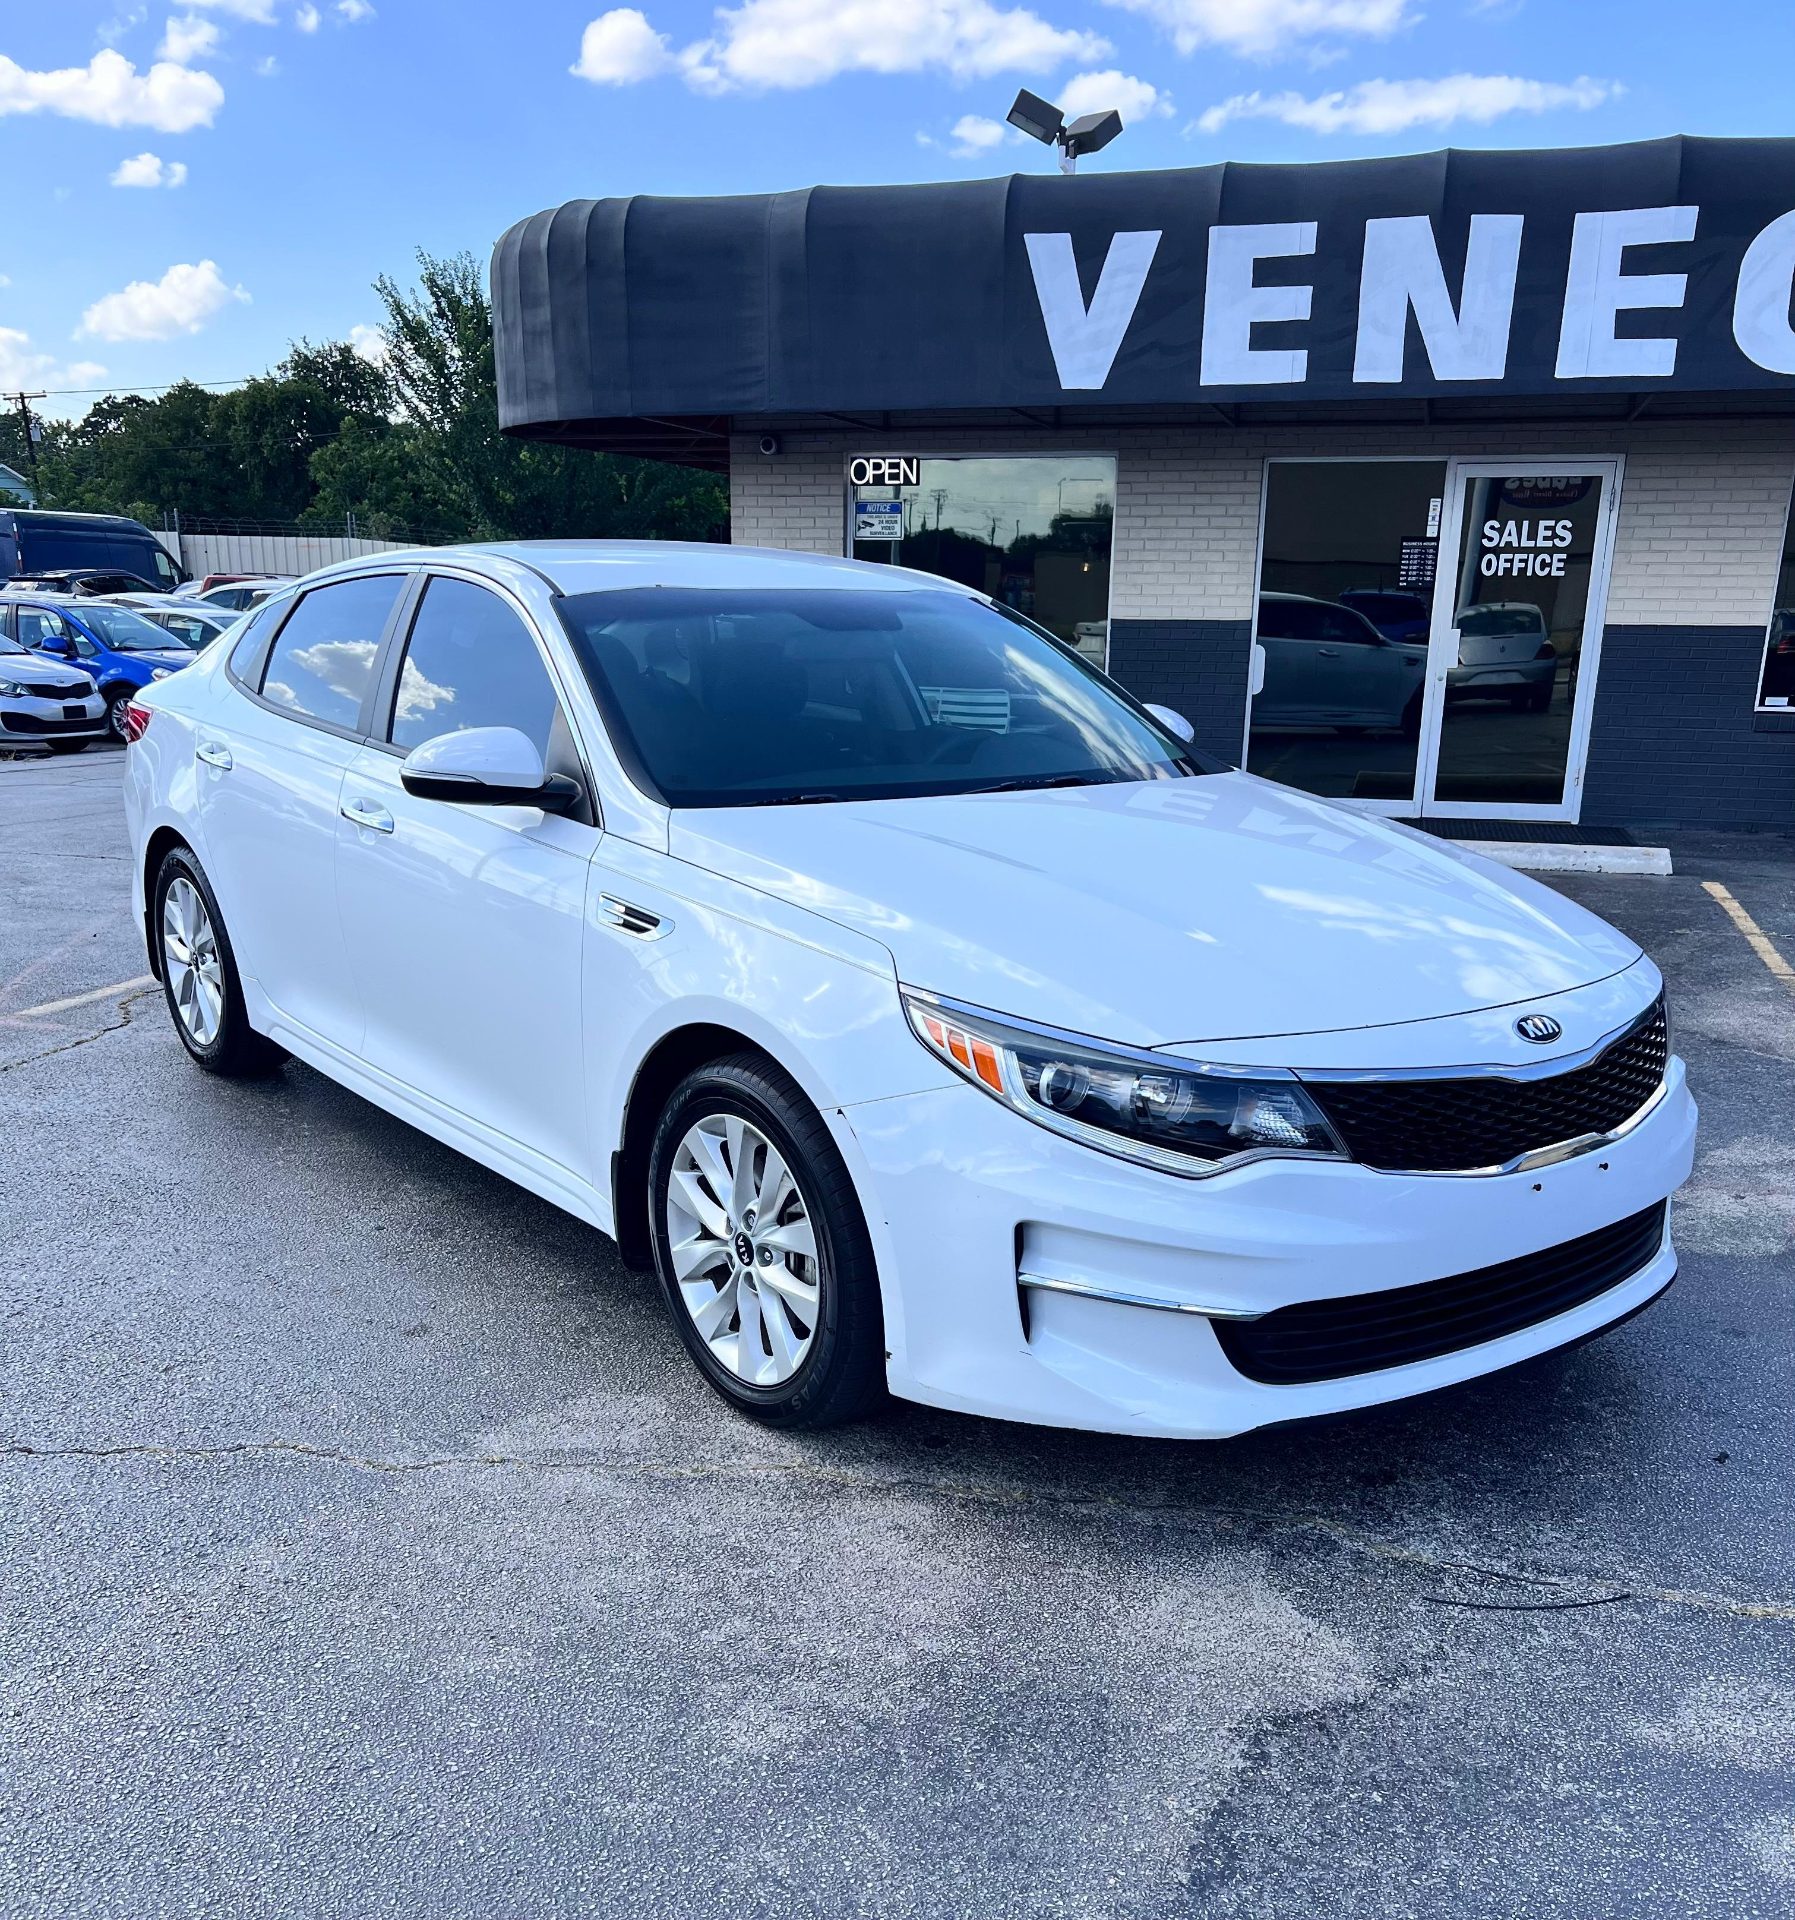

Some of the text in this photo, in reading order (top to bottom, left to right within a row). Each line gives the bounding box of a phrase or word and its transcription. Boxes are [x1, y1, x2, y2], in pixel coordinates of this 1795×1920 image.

[850, 458, 918, 485] OPEN
[866, 504, 891, 512] NOTICE
[1481, 520, 1573, 548] SALES
[1481, 553, 1567, 577] OFFICE
[1519, 1016, 1560, 1038] KIA
[737, 1235, 749, 1264] KIA
